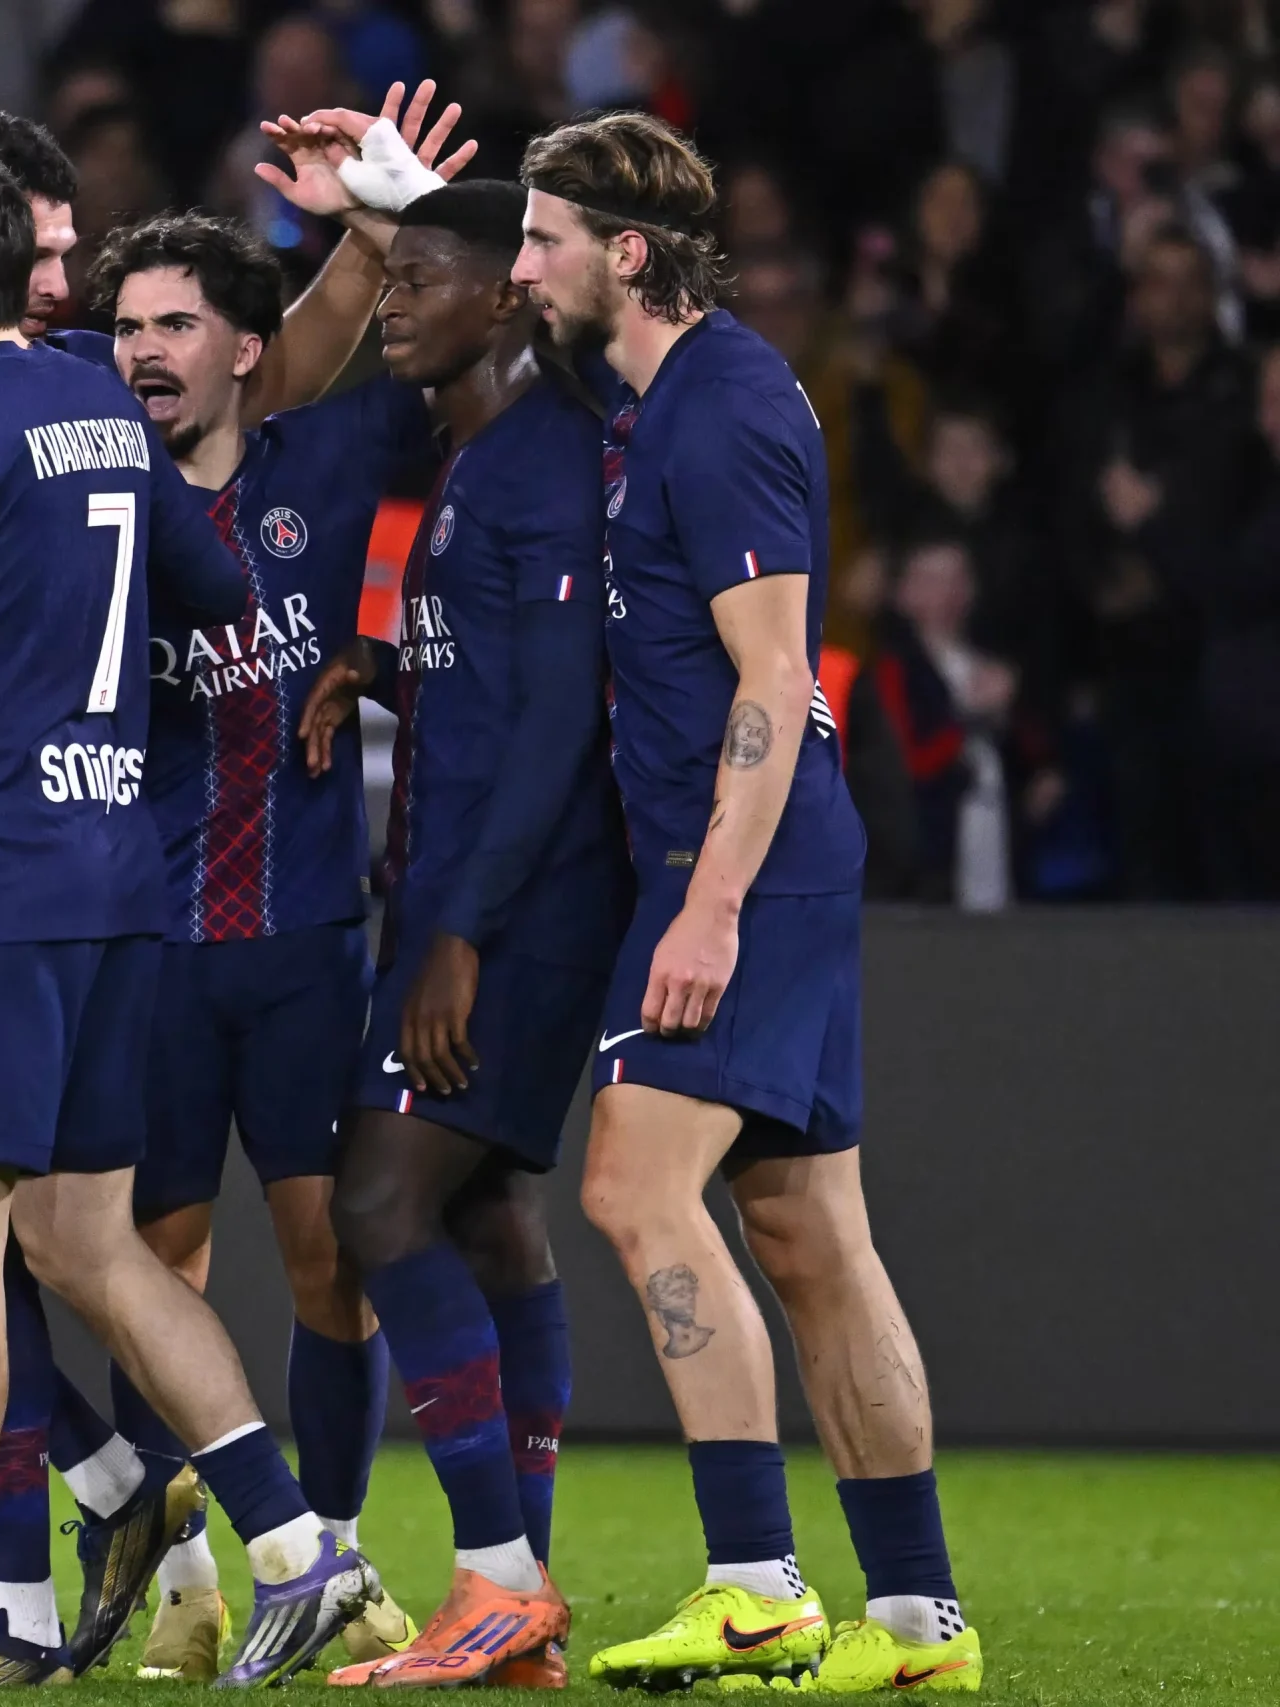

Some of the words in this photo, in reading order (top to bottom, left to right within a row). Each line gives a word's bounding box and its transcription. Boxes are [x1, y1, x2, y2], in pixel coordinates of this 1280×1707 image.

[263, 509, 291, 528] PARIS
[86, 492, 135, 713] 7
[190, 636, 321, 702] AIRWAYS
